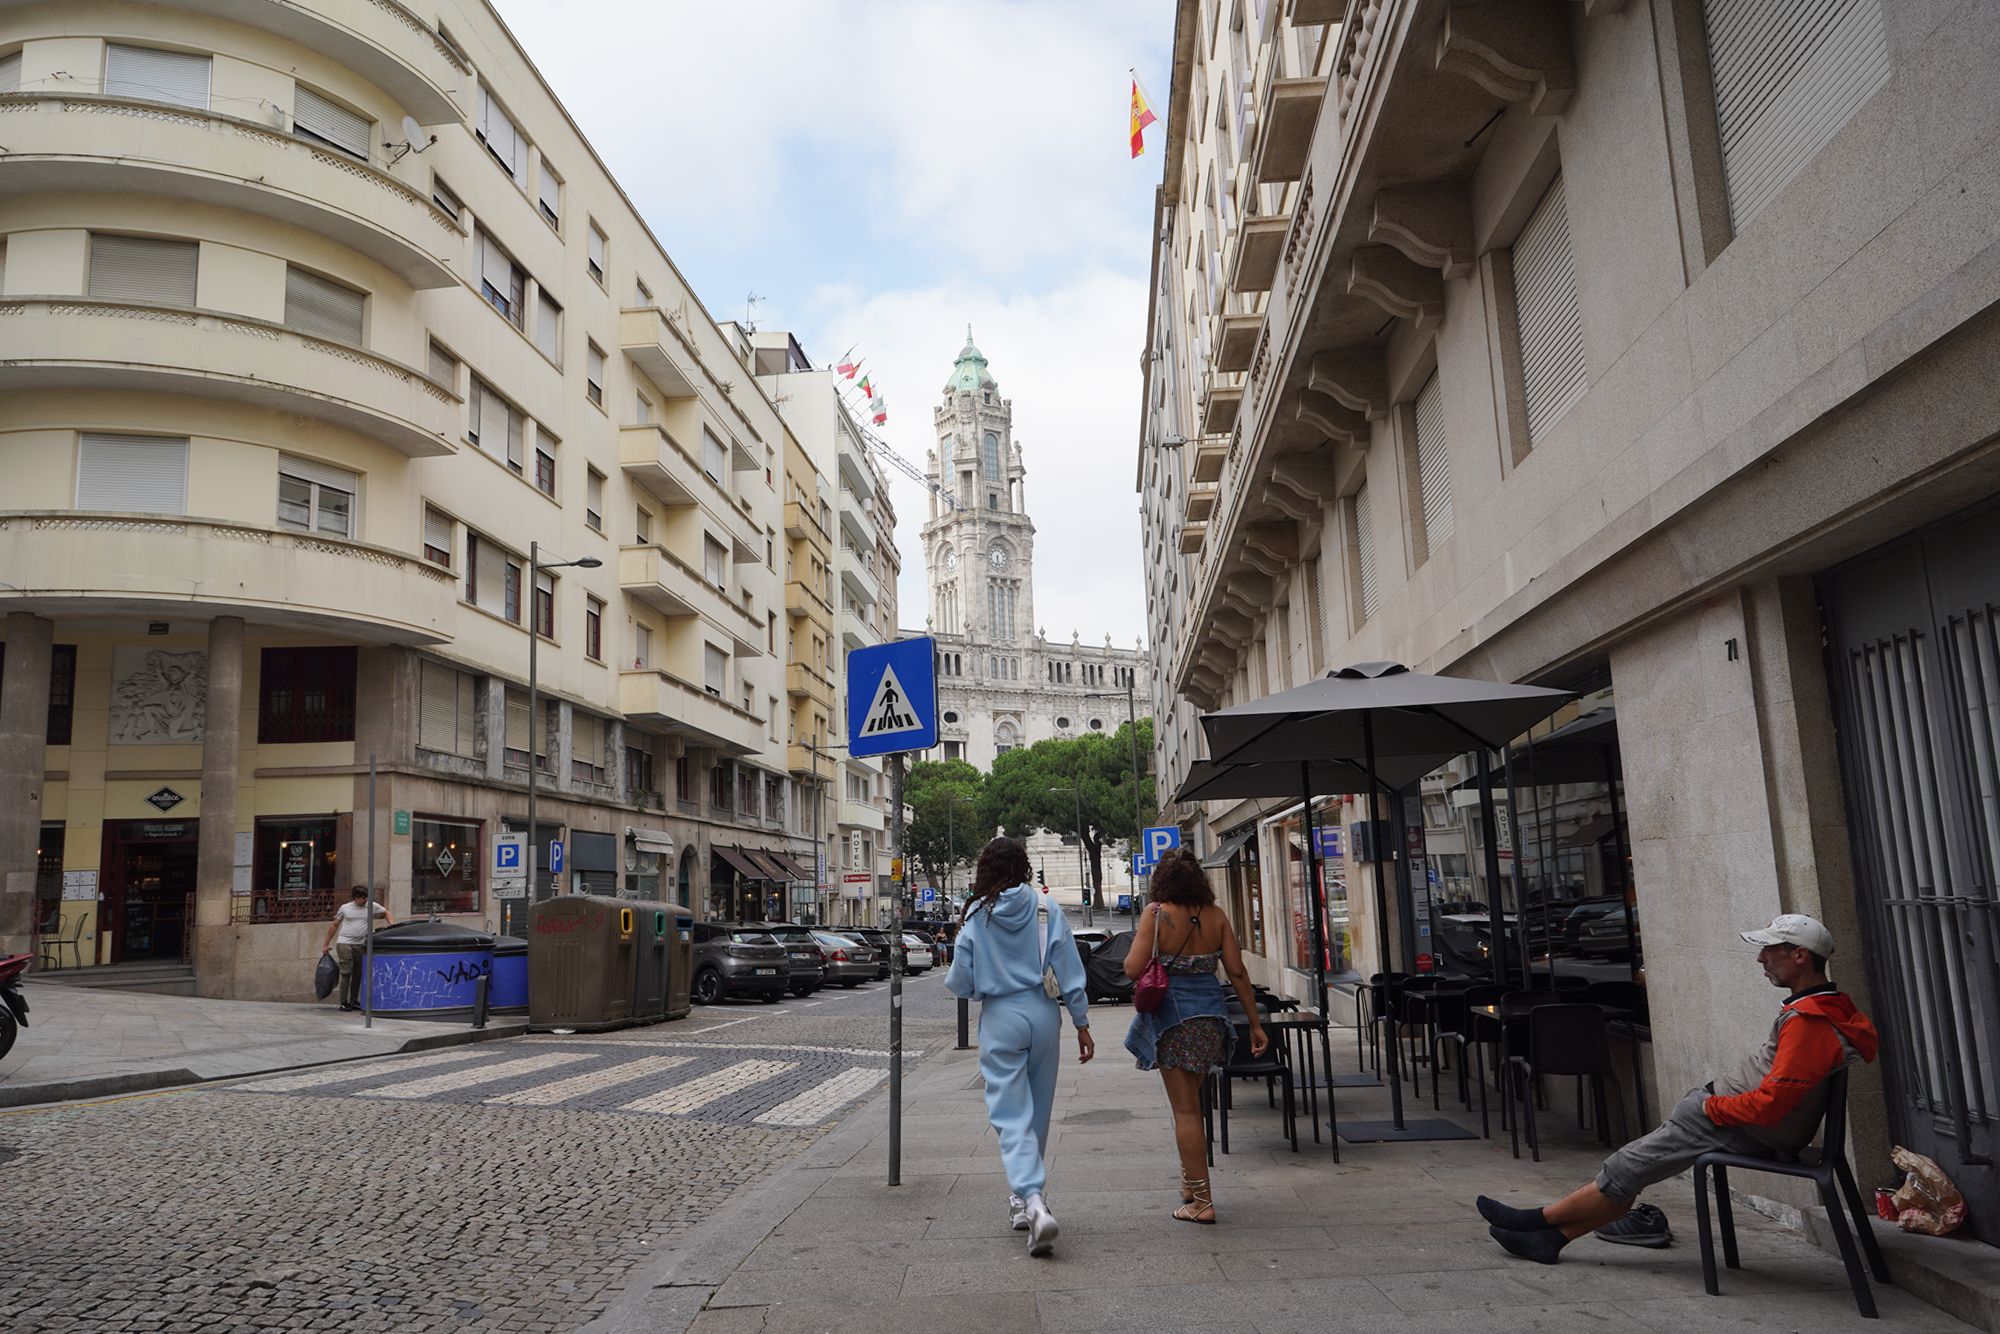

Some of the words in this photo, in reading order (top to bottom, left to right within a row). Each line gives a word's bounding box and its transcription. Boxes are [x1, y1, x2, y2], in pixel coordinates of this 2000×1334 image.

[501, 847, 515, 866] P
[1151, 831, 1171, 860] P
[554, 844, 561, 870] P
[924, 890, 932, 900] P
